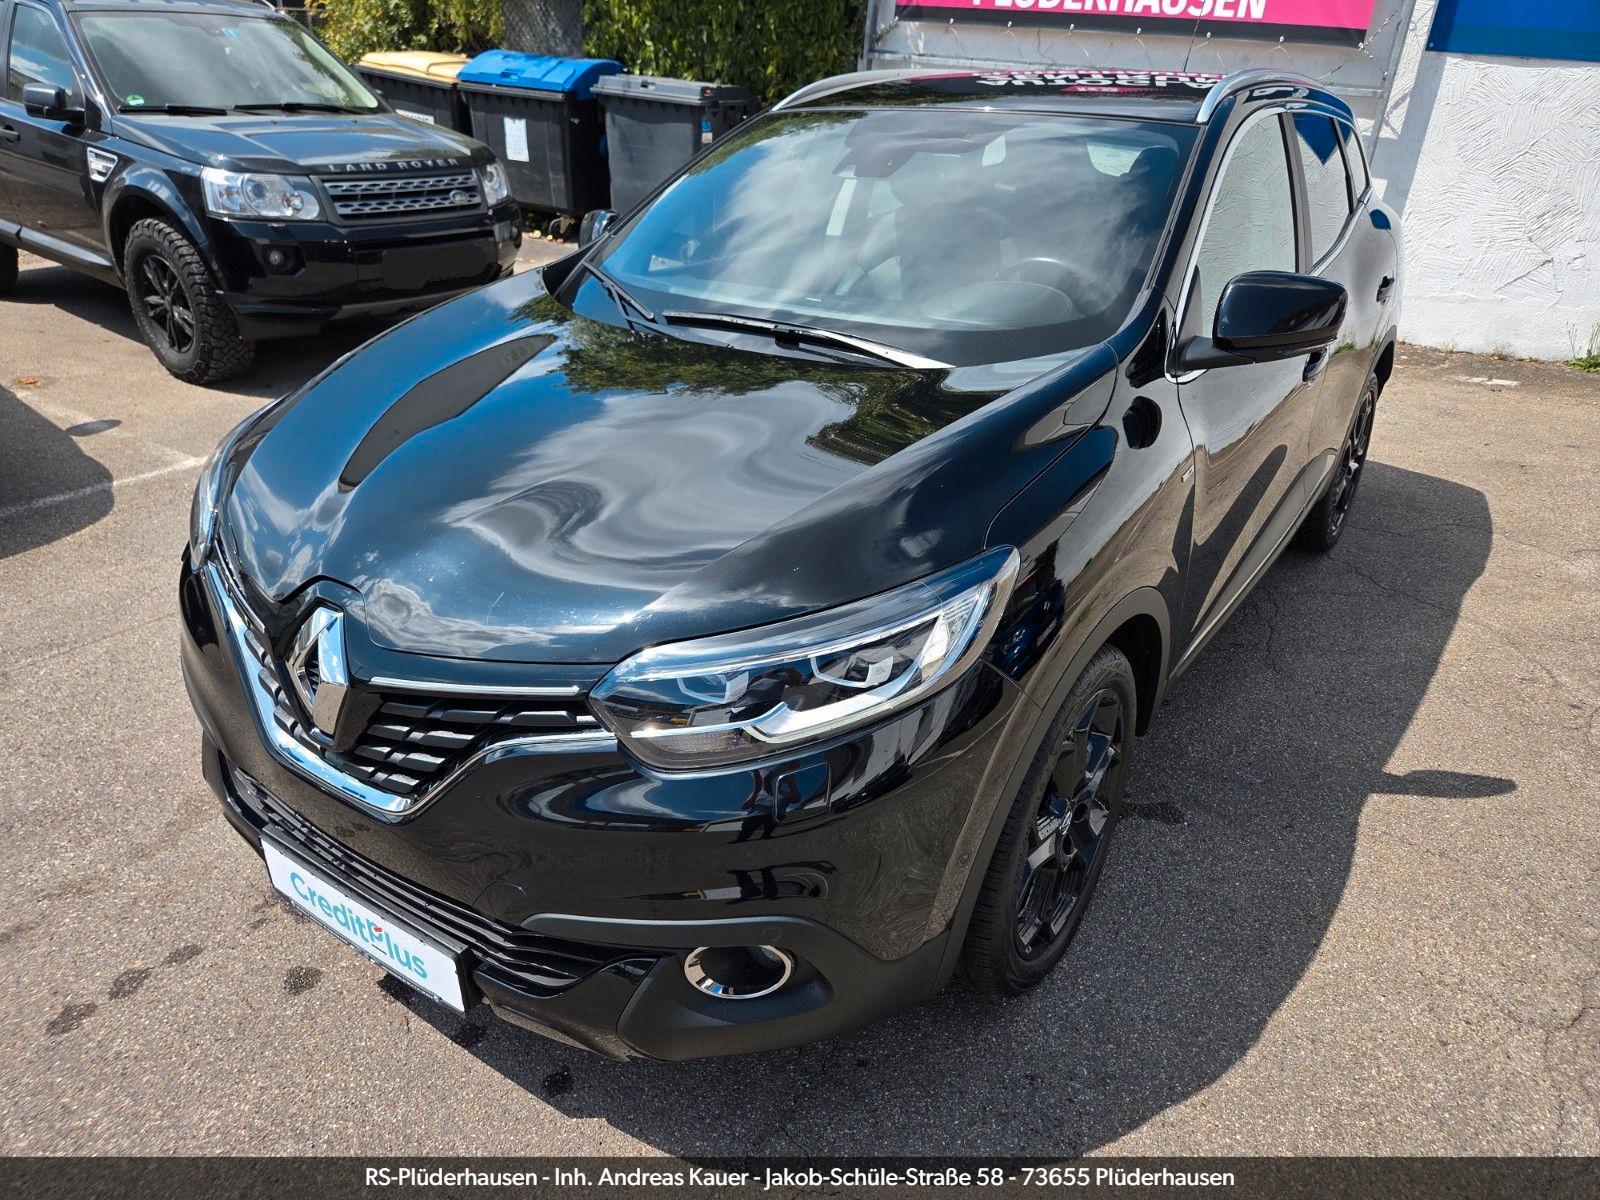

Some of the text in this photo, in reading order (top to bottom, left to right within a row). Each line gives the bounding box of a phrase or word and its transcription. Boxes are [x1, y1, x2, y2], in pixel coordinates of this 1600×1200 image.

[328, 158, 459, 172] LAND ROVER
[290, 871, 428, 980] CreditPlus
